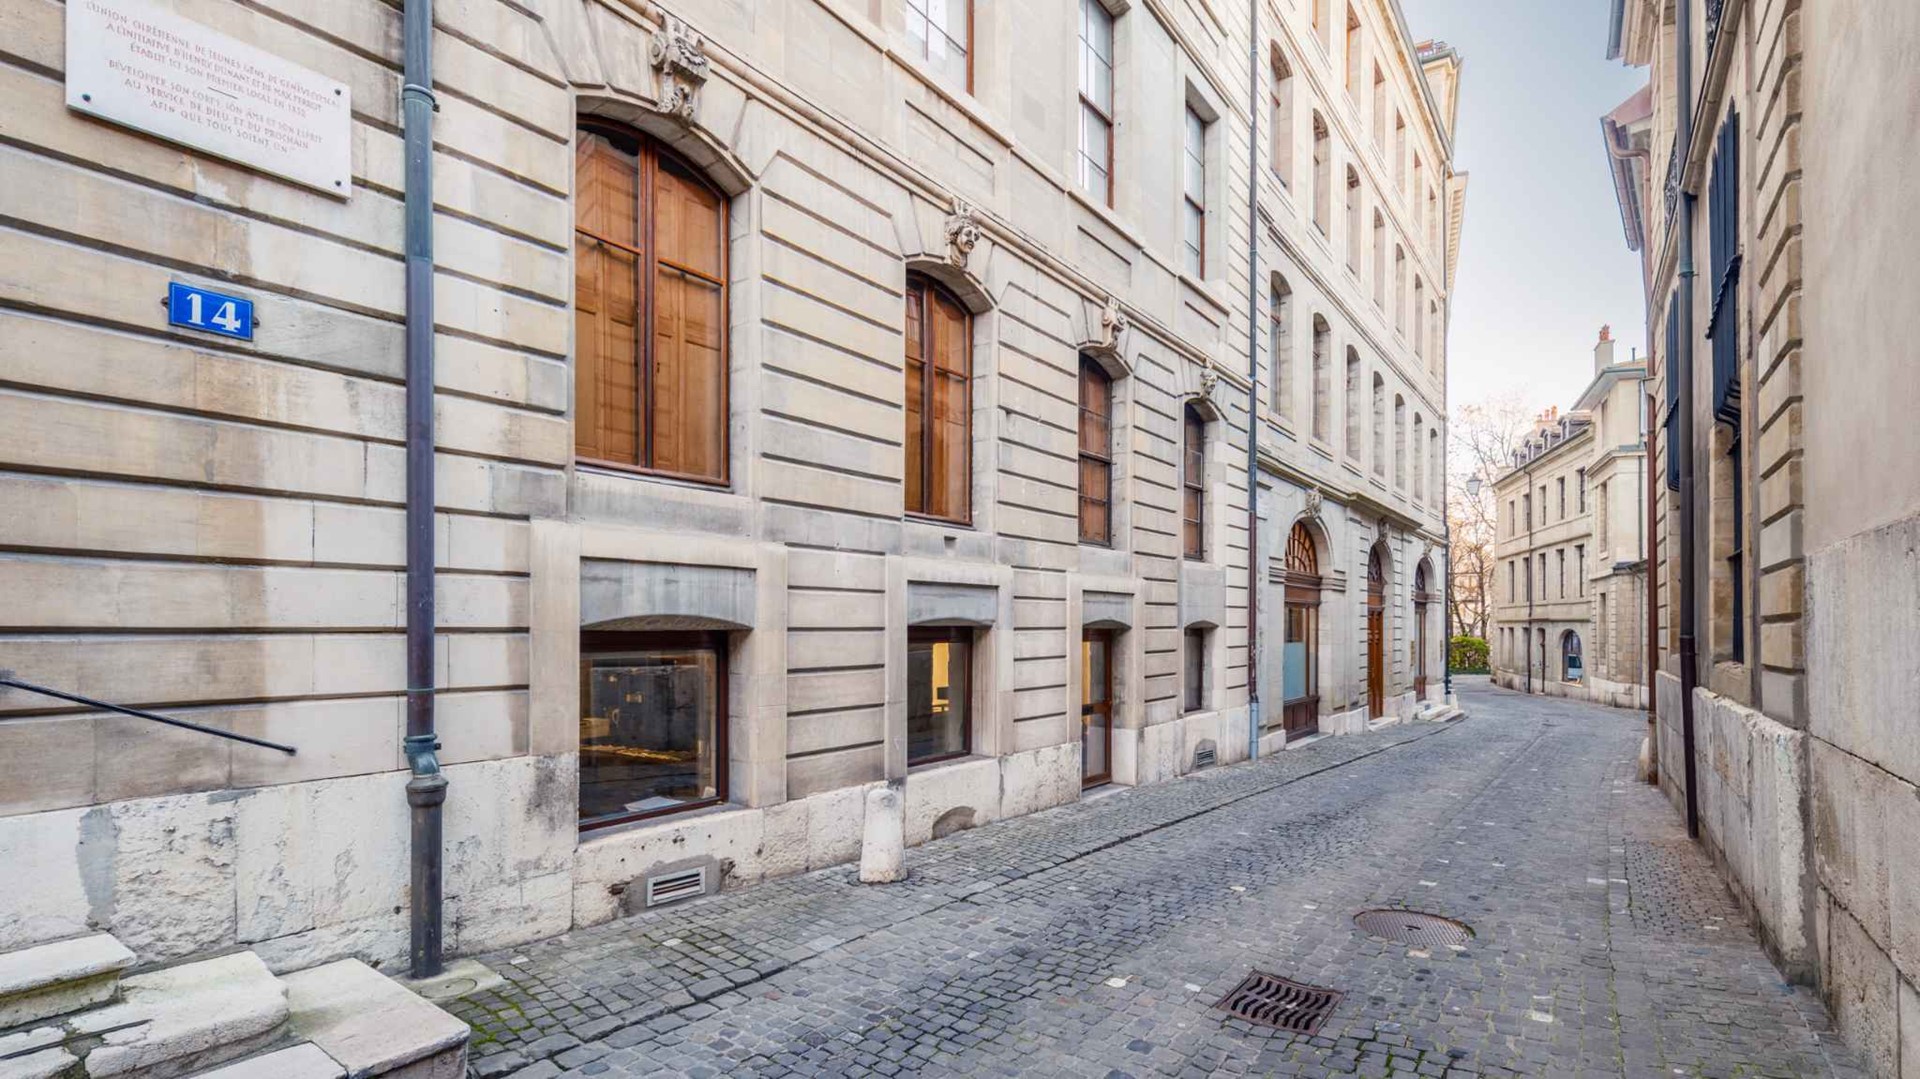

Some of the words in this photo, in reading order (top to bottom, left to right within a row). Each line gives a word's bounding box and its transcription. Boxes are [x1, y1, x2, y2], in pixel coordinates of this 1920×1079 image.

[186, 64, 203, 78] SON
[124, 77, 141, 91] AU
[146, 84, 184, 106] SERVICE
[190, 100, 201, 112] DE
[206, 106, 228, 122] DIEU
[234, 116, 244, 127] ET
[248, 121, 261, 133] DU
[180, 108, 202, 125] QUE
[206, 118, 232, 135] TOUS
[187, 293, 241, 332] 14
